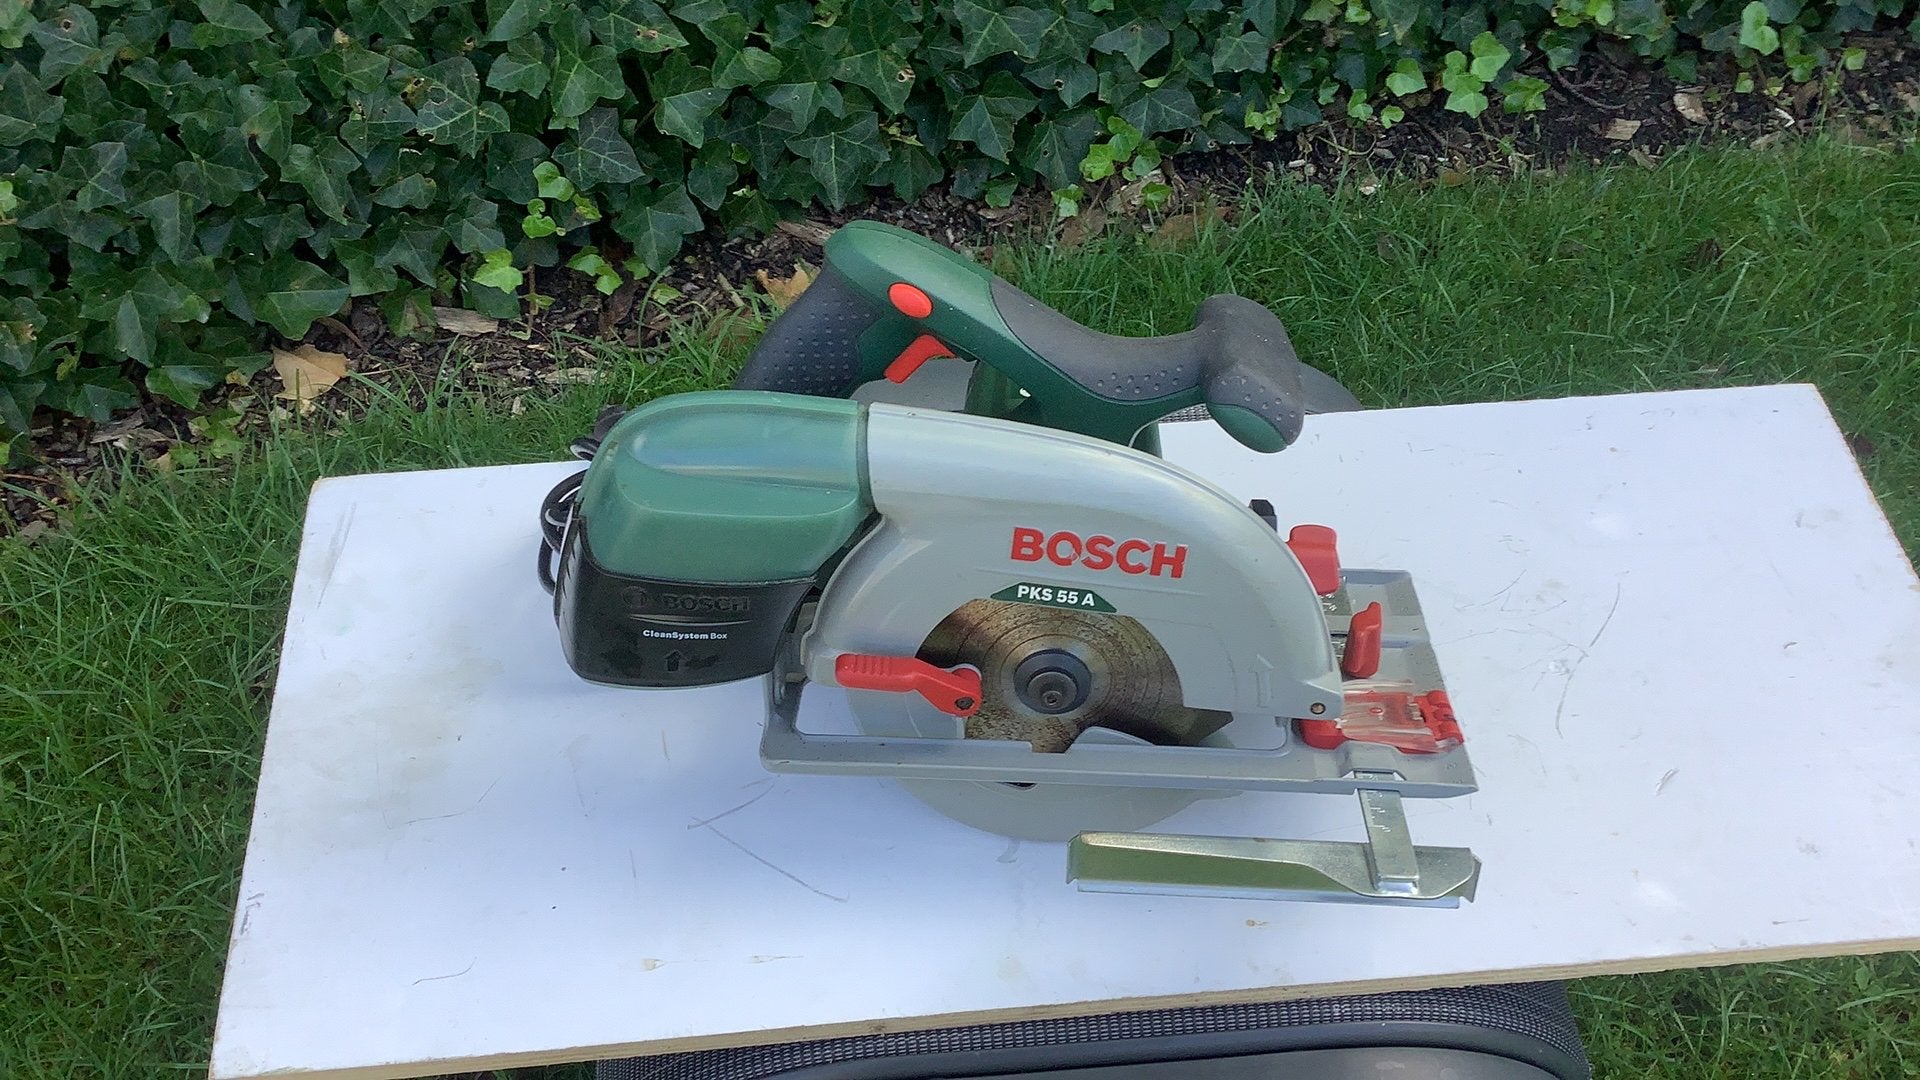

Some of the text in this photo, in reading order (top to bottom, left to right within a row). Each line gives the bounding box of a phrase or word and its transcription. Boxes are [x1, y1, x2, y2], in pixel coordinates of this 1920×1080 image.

[1010, 526, 1189, 579] BOSCH
[661, 593, 750, 612] BOSCH
[1017, 584, 1095, 607] PKS 55 A
[642, 629, 728, 640] CleanSystem Box
